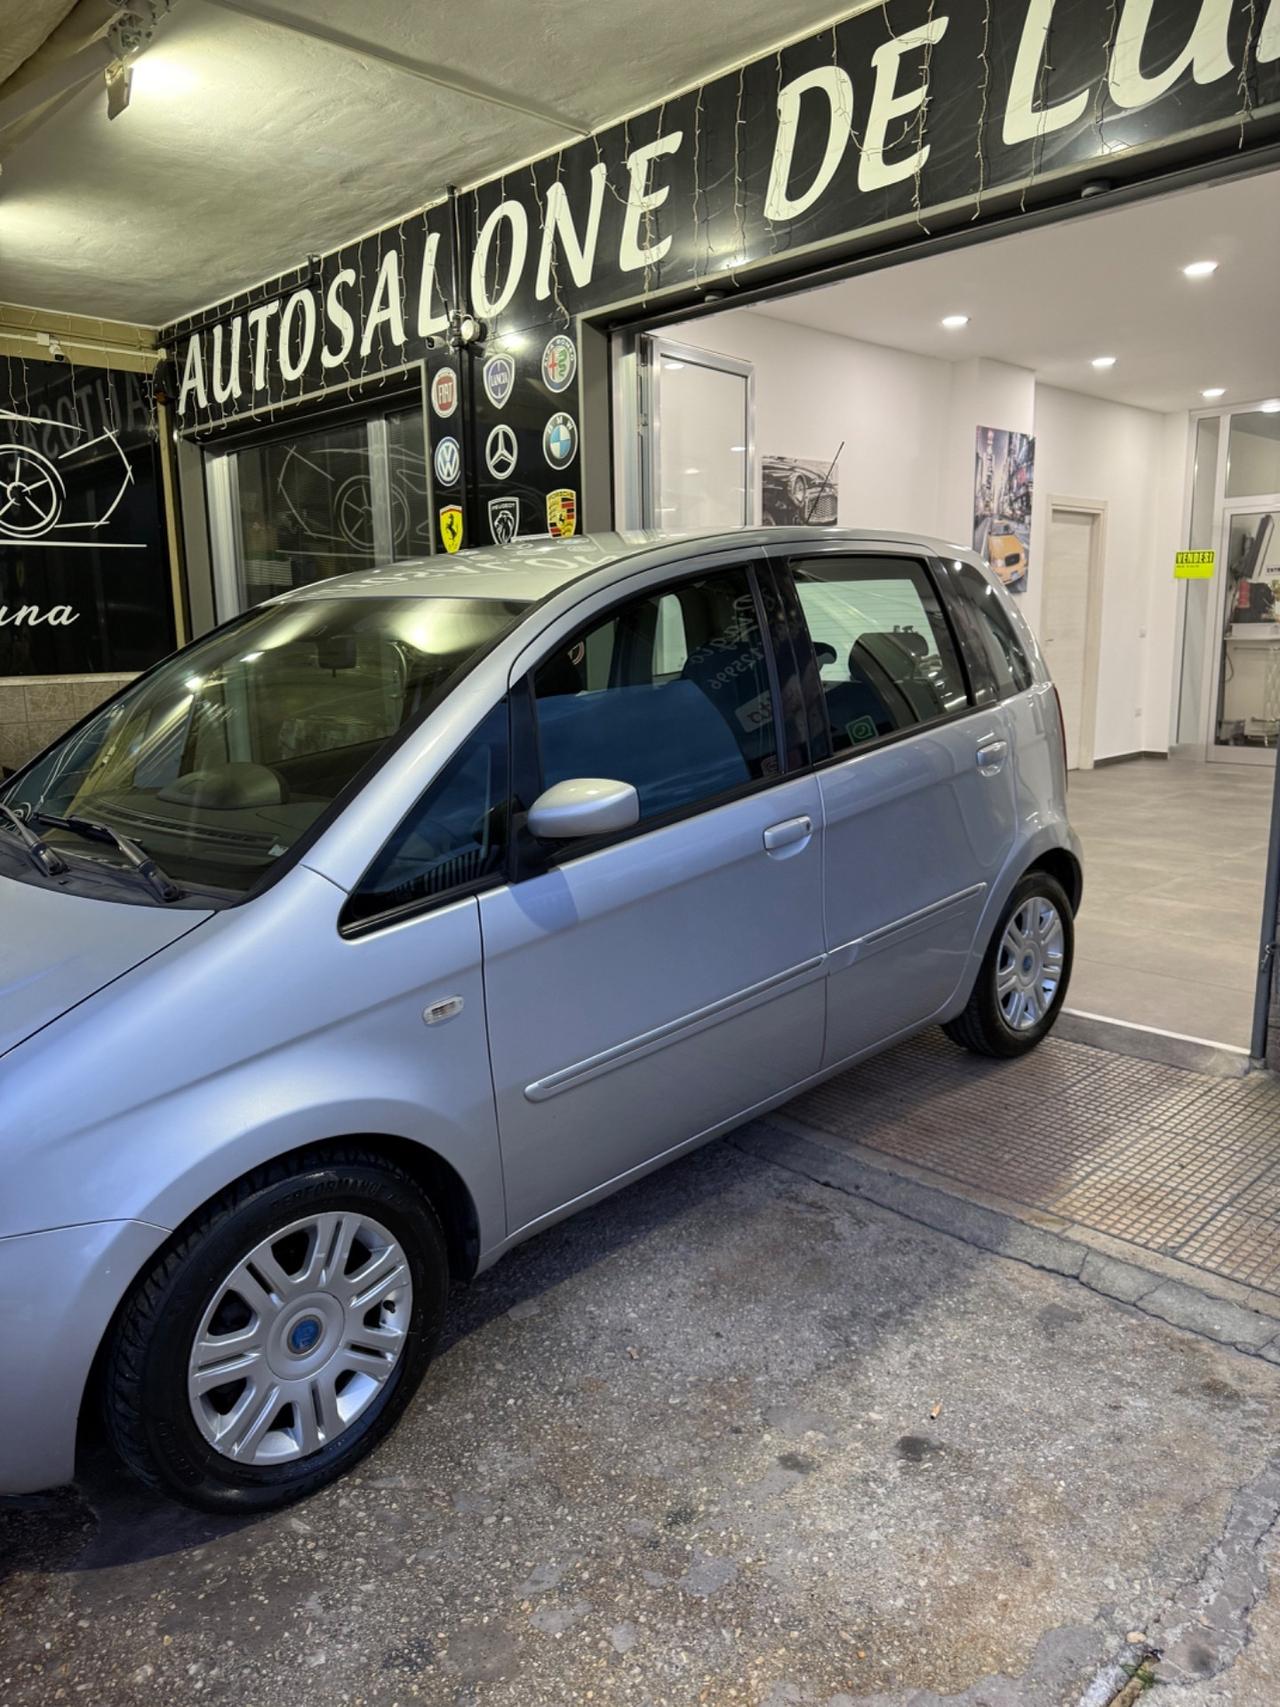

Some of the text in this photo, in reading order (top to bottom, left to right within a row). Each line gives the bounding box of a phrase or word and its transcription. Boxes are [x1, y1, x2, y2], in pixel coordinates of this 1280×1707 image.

[178, 0, 1280, 415] AUTOSALONE DE LU
[1177, 552, 1213, 563] VENDESI
